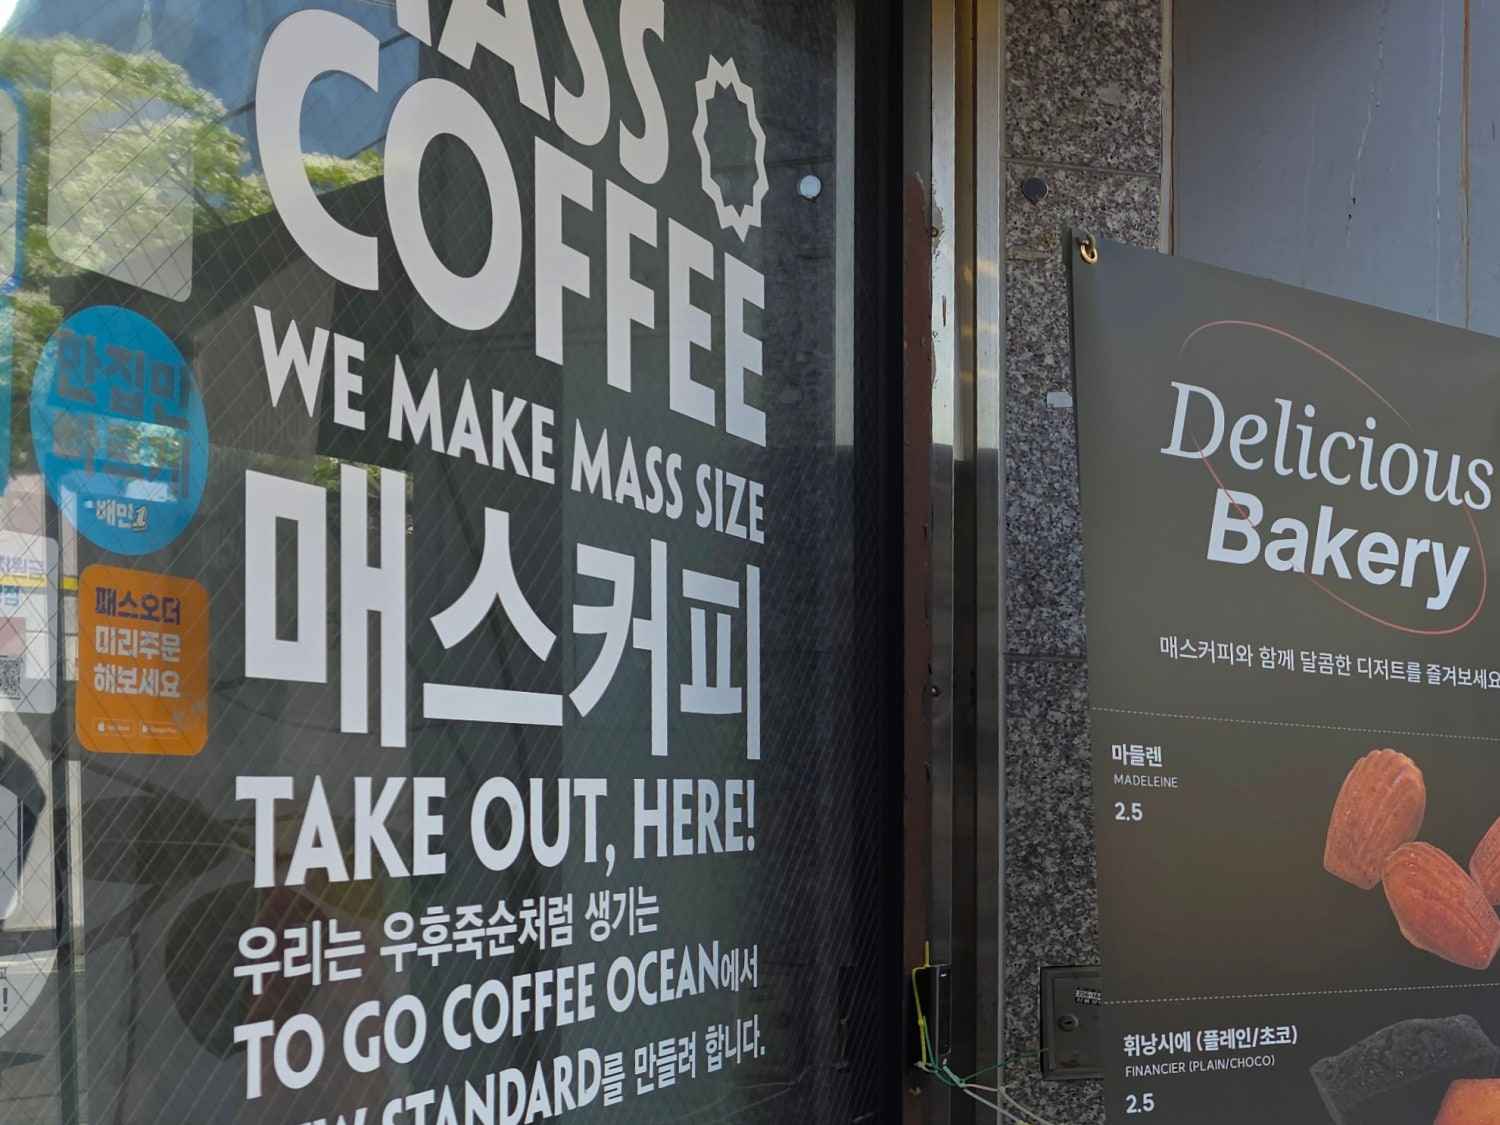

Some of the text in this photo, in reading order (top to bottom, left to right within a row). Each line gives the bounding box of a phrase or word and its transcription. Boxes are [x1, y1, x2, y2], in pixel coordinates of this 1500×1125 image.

[398, 0, 669, 184] ASS
[255, 8, 767, 447] COFFEE
[253, 305, 765, 544] WE MAKE MASS SIZE
[1160, 380, 1494, 511] Delicious
[1206, 487, 1470, 611] Bakery
[95, 587, 181, 626] 패스오더
[245, 464, 761, 760] 매스커피
[95, 625, 181, 663] 미리주문
[1159, 635, 1254, 668] 매스커피와
[1259, 646, 1295, 672] 함께
[1300, 651, 1352, 677] 달콤한
[1357, 657, 1422, 684] 디저트를
[93, 663, 181, 698] 해보세요
[1111, 743, 1163, 768] 마들렌
[1113, 773, 1179, 789] MADELEINE
[235, 775, 757, 889] TAKE OUT, HERE!
[1114, 802, 1143, 822] 2.5
[233, 885, 661, 996] 우리는 우후죽순처럼 생기는
[233, 939, 760, 1100] TO GO COFFEE OCEAN에서
[1123, 1024, 1298, 1058] 휘낭시에 (플레인/초코)
[633, 1038, 698, 1097] 만들려
[704, 1015, 766, 1074] 합니다.
[1125, 1054, 1276, 1078] FINANCIER (PLAIN/CHOCO)
[1125, 1092, 1156, 1115] 2.5
